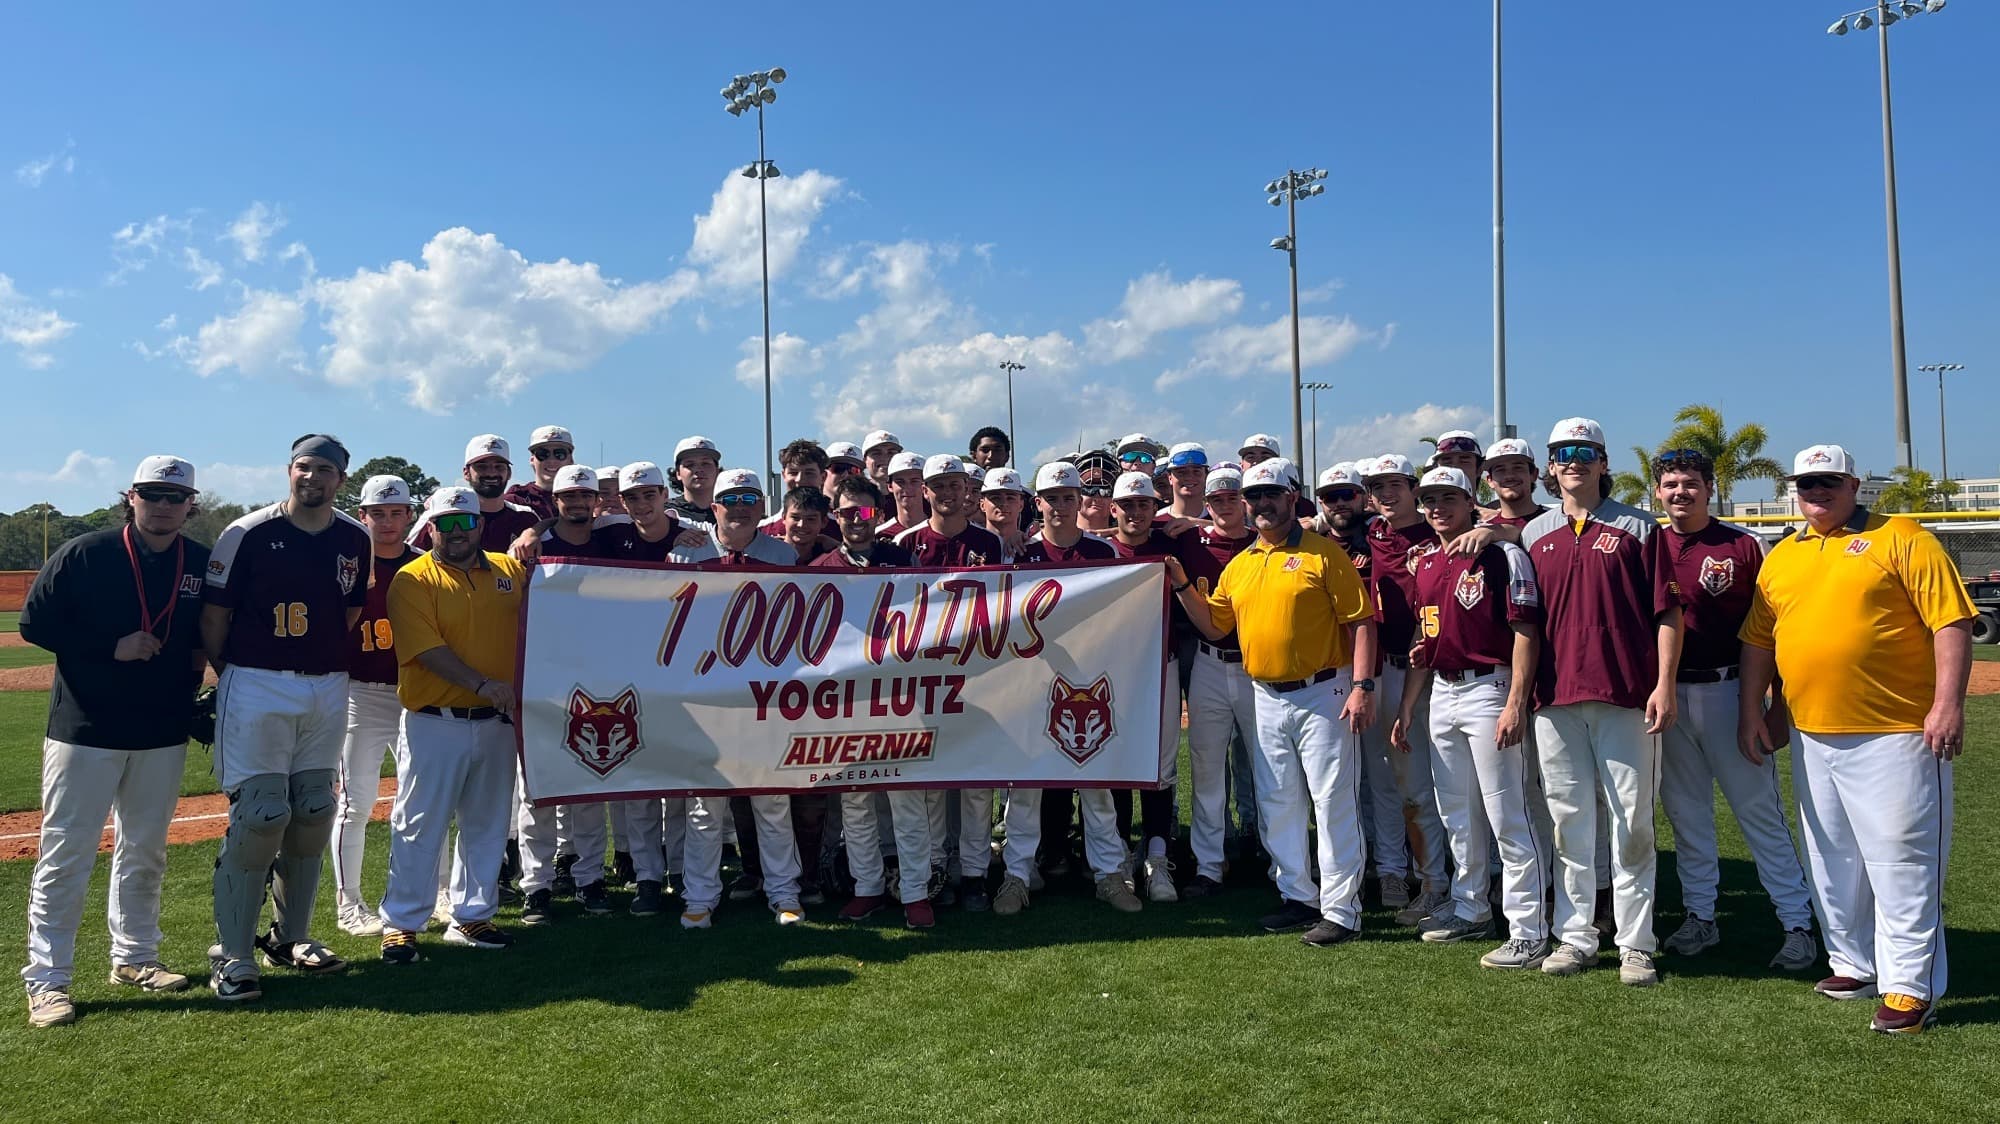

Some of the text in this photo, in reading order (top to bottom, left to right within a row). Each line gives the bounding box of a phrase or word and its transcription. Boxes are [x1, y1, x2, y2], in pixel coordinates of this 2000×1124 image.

[1592, 533, 1619, 553] AU
[1847, 538, 1870, 554] AU
[1284, 556, 1304, 571] AU
[180, 575, 202, 594] AU
[496, 577, 512, 592] AU
[273, 602, 308, 637] 16
[656, 573, 1063, 676] 1,000 WINS
[360, 618, 393, 651] 19
[749, 674, 966, 721] YOGI LUTZ
[783, 731, 935, 766] ALVERNIA
[809, 767, 902, 783] BASEBALL
